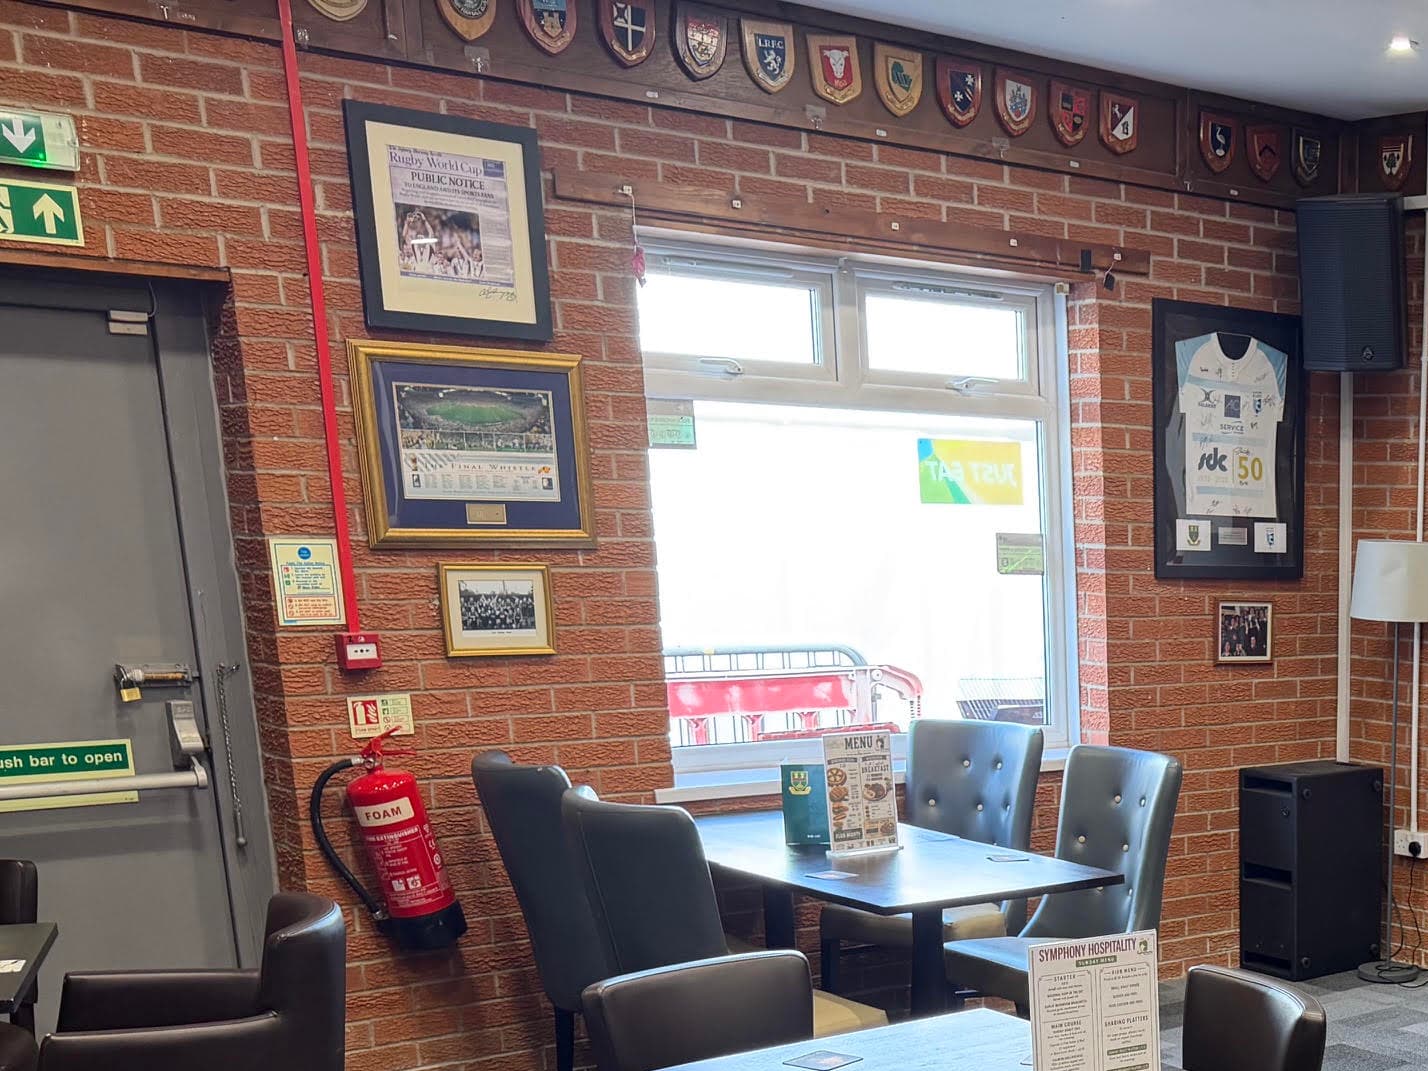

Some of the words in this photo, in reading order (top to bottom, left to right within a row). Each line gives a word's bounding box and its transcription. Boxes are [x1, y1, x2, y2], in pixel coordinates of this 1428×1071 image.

[389, 151, 424, 169] Rugby
[427, 157, 460, 172] World
[460, 163, 483, 177] Cup
[410, 172, 447, 187] PUBLIC
[448, 177, 485, 190] NOTICE
[1219, 423, 1245, 432] SERVICE
[1238, 455, 1263, 481] 50
[844, 735, 873, 750] MENU
[29, 755, 55, 767] bar
[61, 753, 78, 765] to
[84, 752, 123, 765] open
[365, 806, 402, 821] FOAM
[1038, 943, 1086, 963] SYMPHONY
[1088, 938, 1137, 957] HOSPITALITY
